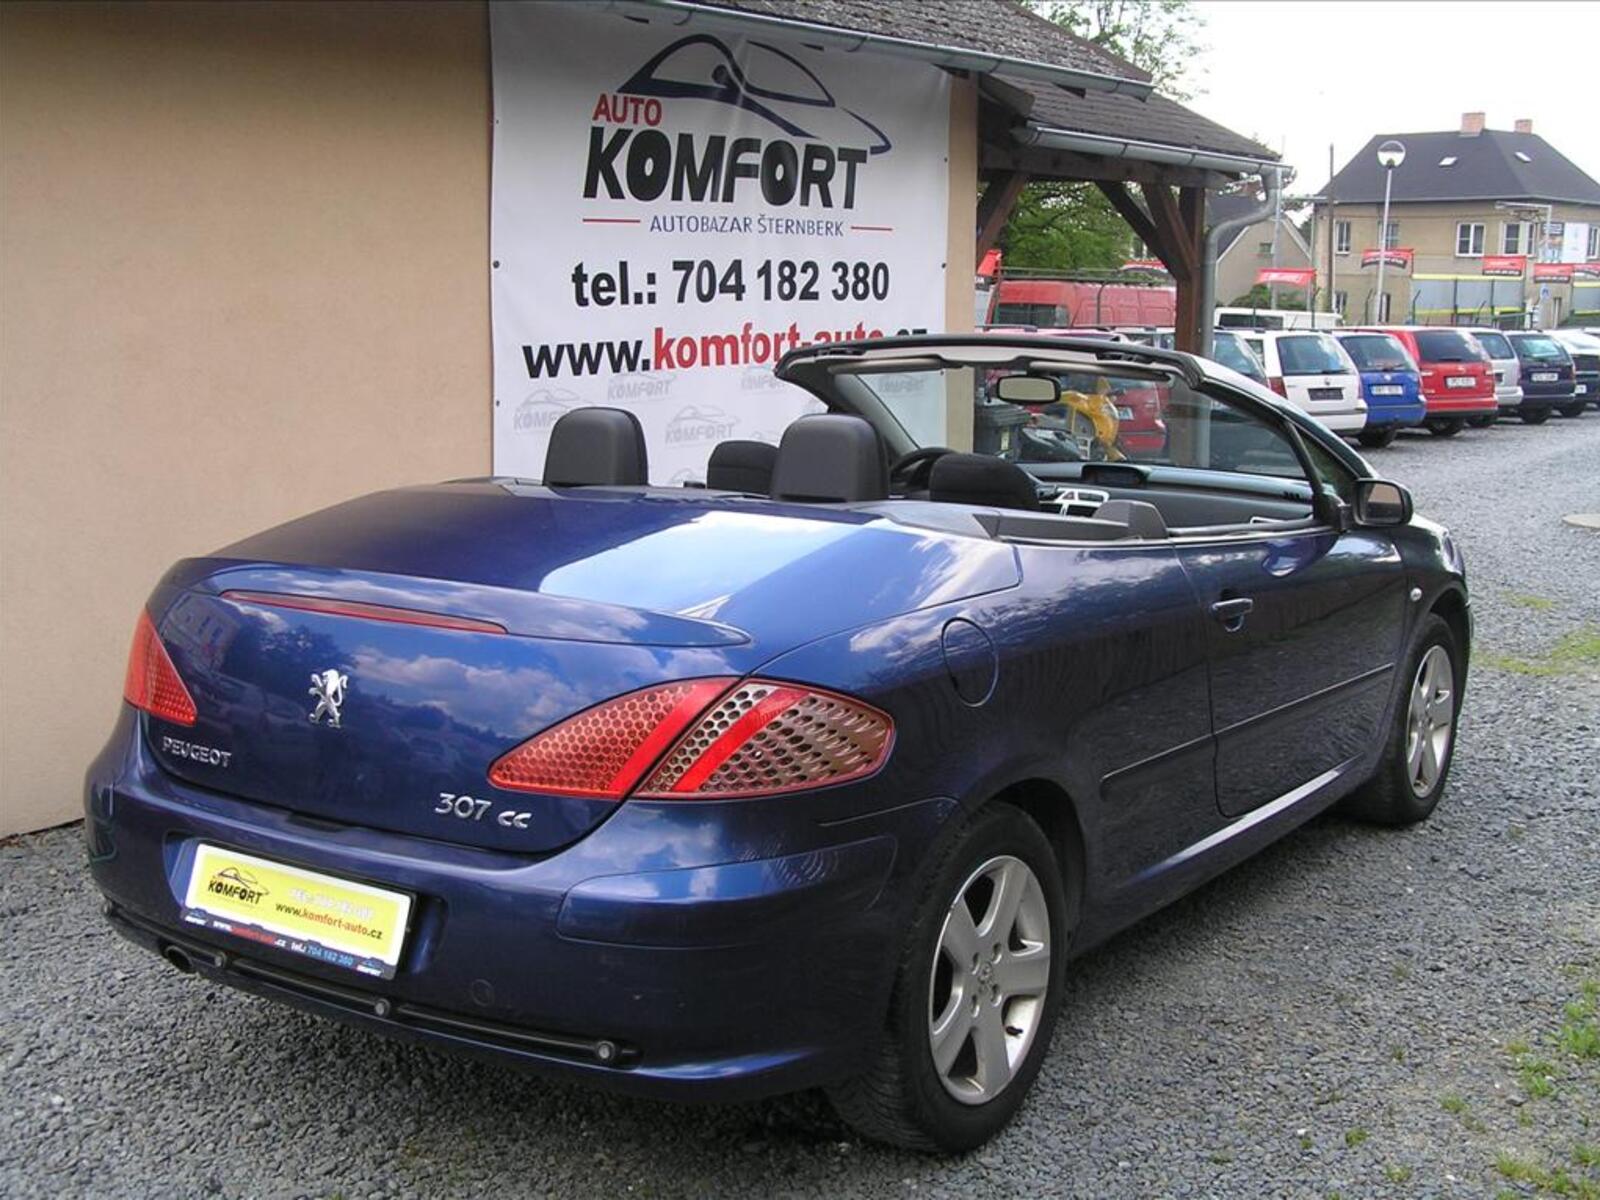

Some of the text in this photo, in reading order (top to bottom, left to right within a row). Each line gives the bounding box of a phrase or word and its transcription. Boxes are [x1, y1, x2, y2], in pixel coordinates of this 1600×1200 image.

[592, 93, 663, 127] AUTO
[583, 126, 868, 210] KOMFORT
[649, 213, 844, 237] AUTOBAZAR ŠTERNBERK
[571, 259, 890, 307] tel.: 704 182 380
[522, 322, 928, 380] www.komfort-
[162, 736, 232, 768] PEUGEOT
[435, 793, 492, 820] 307
[207, 880, 263, 905] KOMFORT
[275, 901, 383, 940] www.komfort-auto.cz
